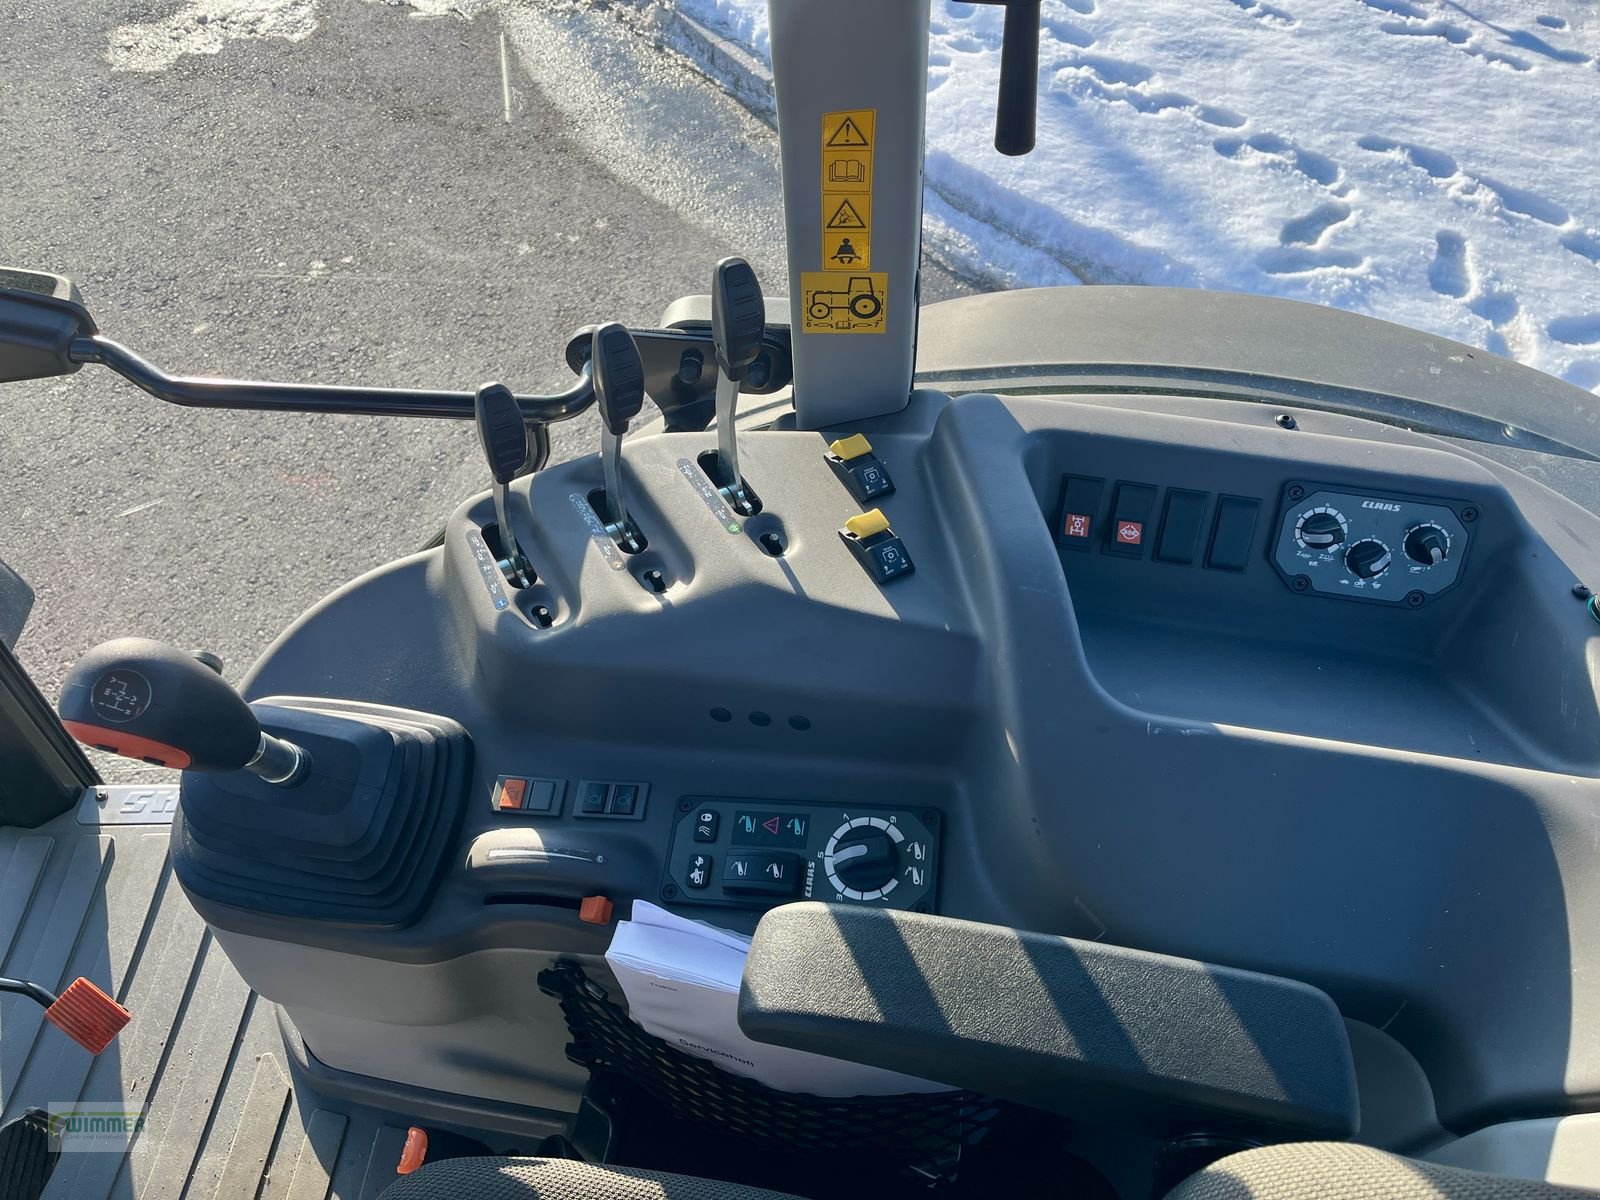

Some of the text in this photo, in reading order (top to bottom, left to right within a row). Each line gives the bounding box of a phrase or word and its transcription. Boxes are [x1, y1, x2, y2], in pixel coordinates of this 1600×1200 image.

[1361, 500, 1401, 512] CLAAS
[818, 851, 824, 859] 5
[804, 860, 816, 898] CLAAS
[679, 1038, 755, 1068] Serviceheft
